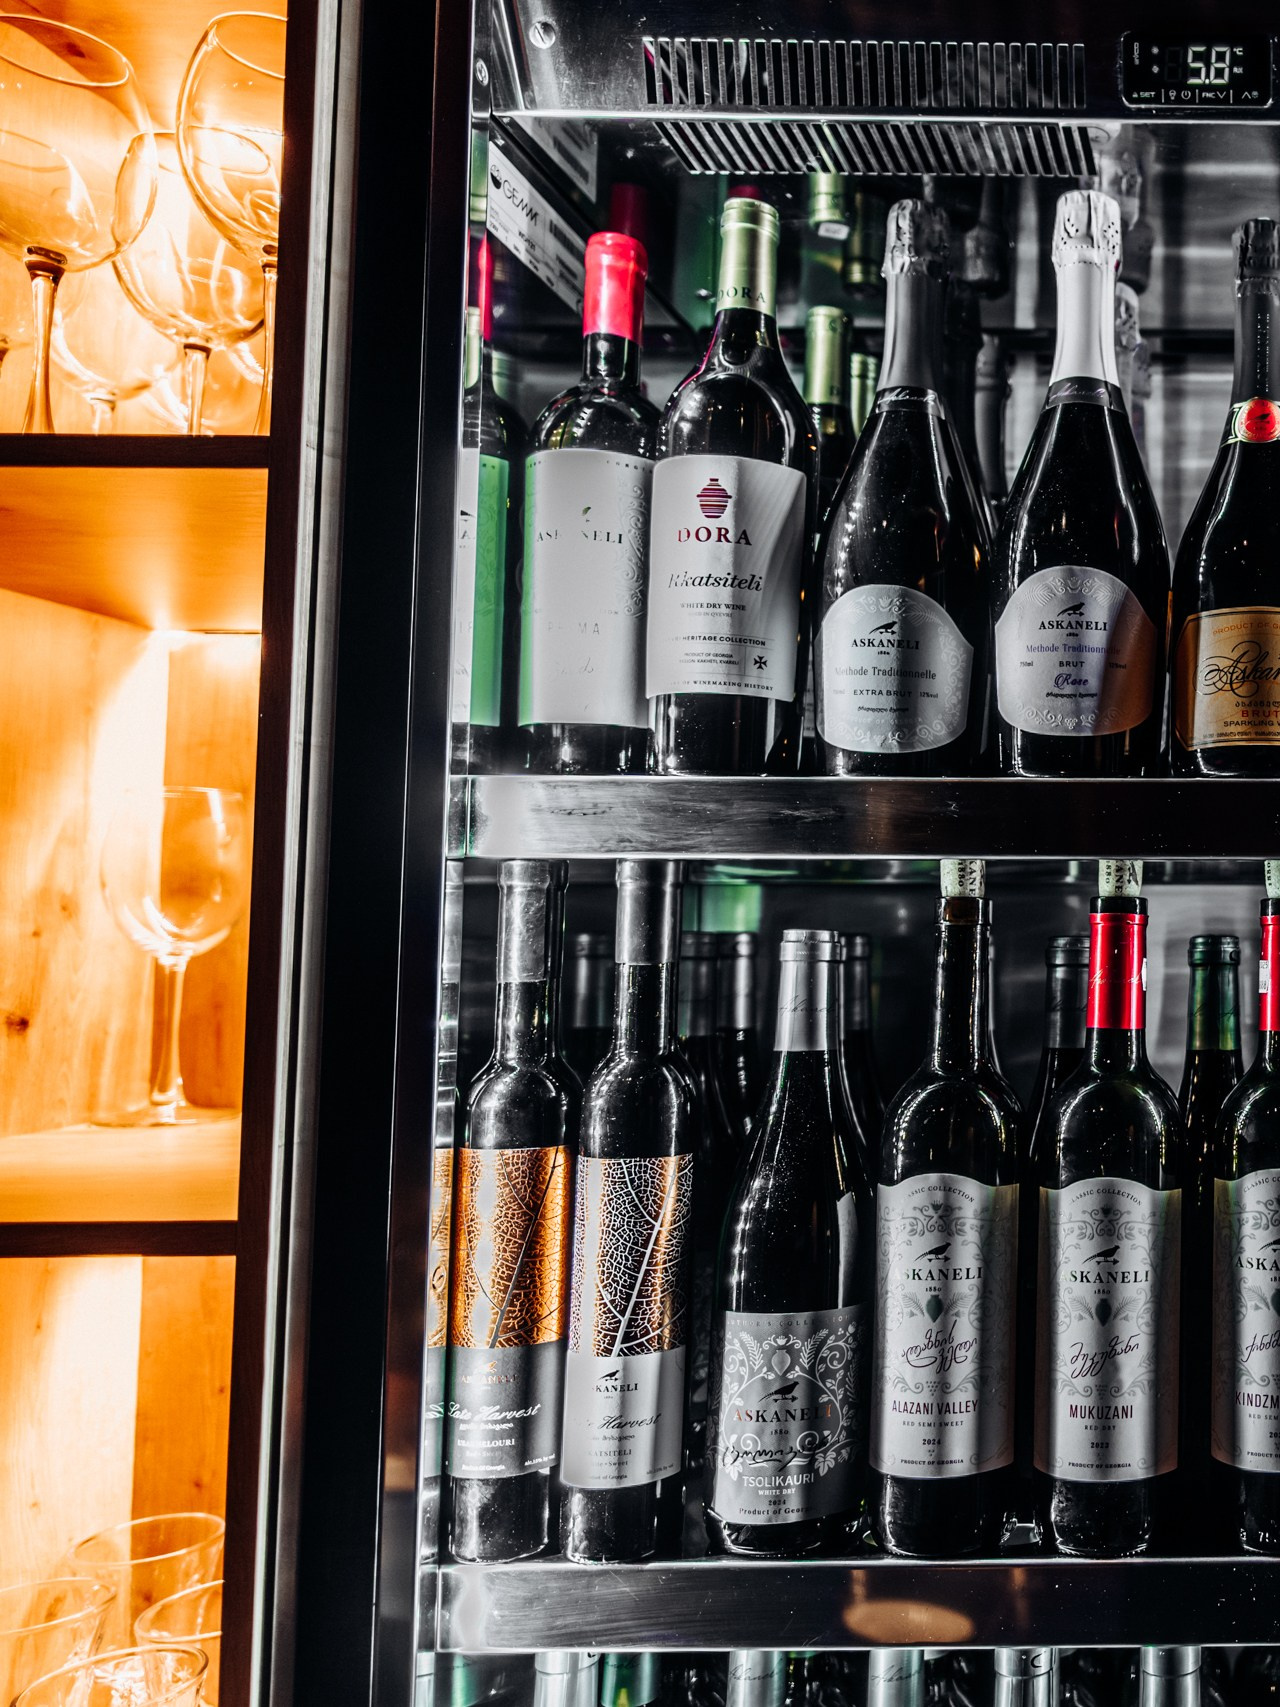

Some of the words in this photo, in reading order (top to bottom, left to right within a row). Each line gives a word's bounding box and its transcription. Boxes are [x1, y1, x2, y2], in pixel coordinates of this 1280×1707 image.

[1187, 46, 1231, 85] 5.8
[677, 526, 752, 546] DORA
[724, 603, 746, 611] WINE
[1038, 620, 1108, 631] ASKANELI
[1212, 622, 1253, 637] PRODUCT
[719, 636, 766, 646] COLLECTION
[852, 638, 920, 650] ASKANELI
[1026, 643, 1060, 653] Methode
[693, 680, 742, 688] WINEMAKING
[744, 683, 774, 691] HISTORY
[1053, 673, 1089, 690] Rose
[1242, 709, 1280, 718] BRUT
[1223, 720, 1275, 728] SPARKLING
[928, 1185, 975, 1203] COLLECTION
[1069, 1189, 1095, 1204] LASSIC
[1096, 1188, 1142, 1206] COLLECTION
[905, 1266, 984, 1281] SKANELI
[1061, 1270, 1149, 1284] SKANELI
[591, 1383, 639, 1393] KANELI
[473, 1403, 541, 1421] Harvest
[733, 1403, 833, 1423] ASKANELI
[892, 1399, 934, 1415] ALAZANI
[936, 1399, 979, 1415] VALLEY
[1069, 1404, 1133, 1420] MUKUZANI
[597, 1413, 662, 1430] Harvest
[937, 1458, 964, 1466] GEORGIA
[742, 1472, 815, 1487] TSOLIKAURI
[739, 1507, 770, 1515] Product
[773, 1507, 782, 1515] of
